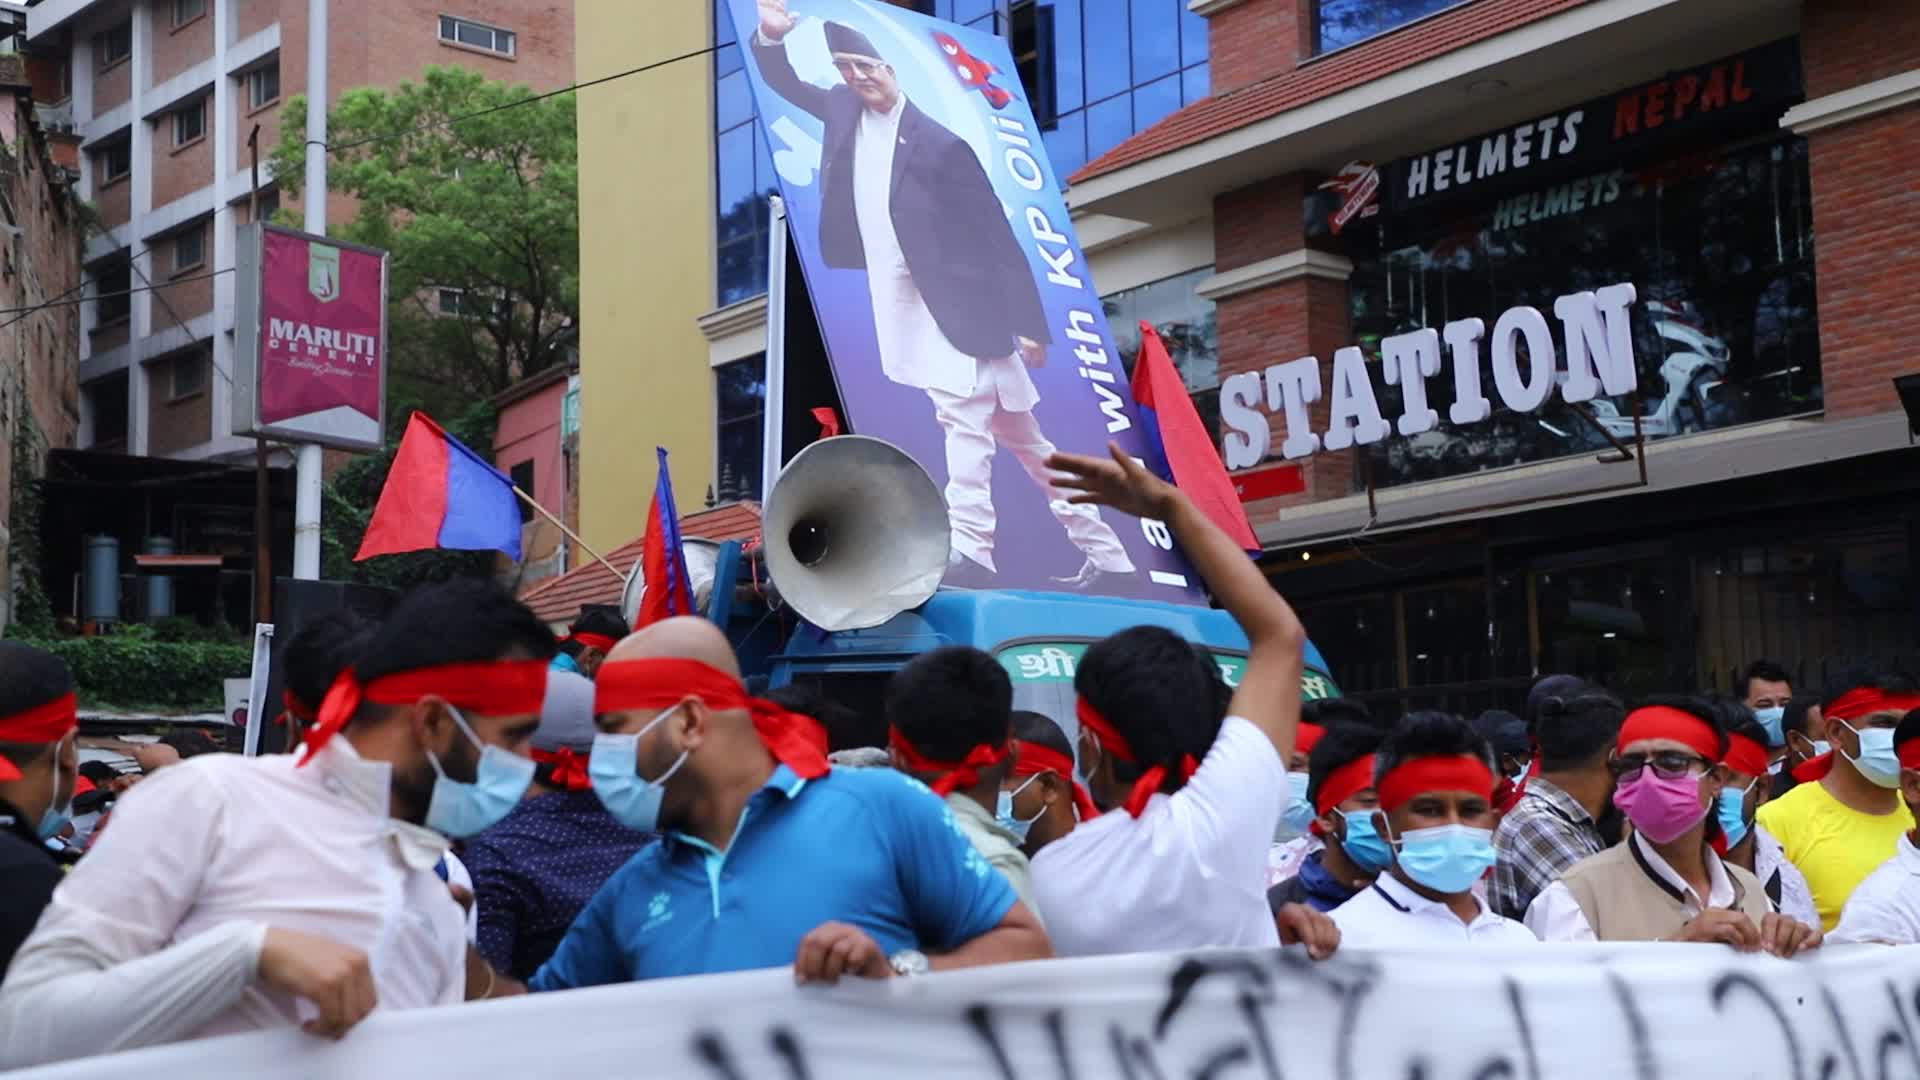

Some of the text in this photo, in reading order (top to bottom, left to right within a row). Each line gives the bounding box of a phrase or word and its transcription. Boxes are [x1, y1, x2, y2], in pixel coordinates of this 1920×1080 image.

[990, 115, 1044, 191] Oli
[1407, 110, 1585, 198] HELMETS
[1613, 60, 1753, 139] NEPAL
[1493, 168, 1624, 232] HELMETS
[1025, 206, 1084, 290] KP
[268, 339, 375, 366] CEMENT
[270, 317, 375, 355] MARUTI
[1065, 309, 1132, 433] with
[1219, 282, 1637, 471] STATION
[1149, 570, 1188, 588] I
[1016, 647, 1076, 678] श्री
